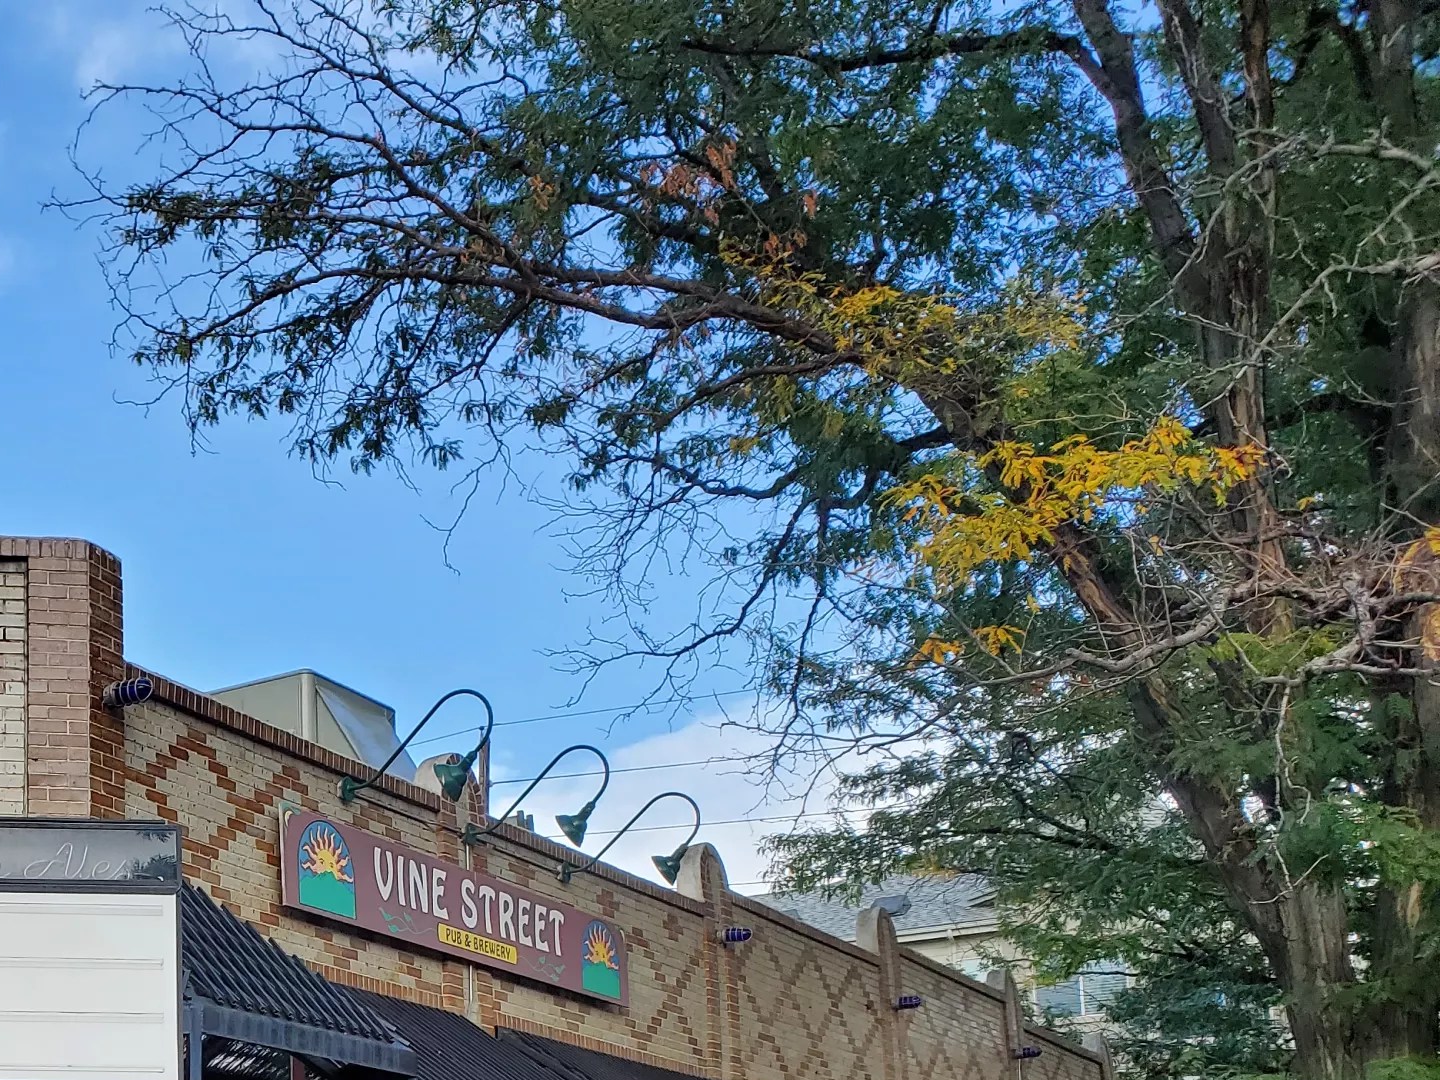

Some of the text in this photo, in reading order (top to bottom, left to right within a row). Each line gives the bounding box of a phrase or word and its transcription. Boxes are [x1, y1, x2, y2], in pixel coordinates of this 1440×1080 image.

[23, 841, 132, 880] Ales
[372, 846, 565, 957] VINE STREET
[445, 928, 511, 960] PUB & BREWERY
